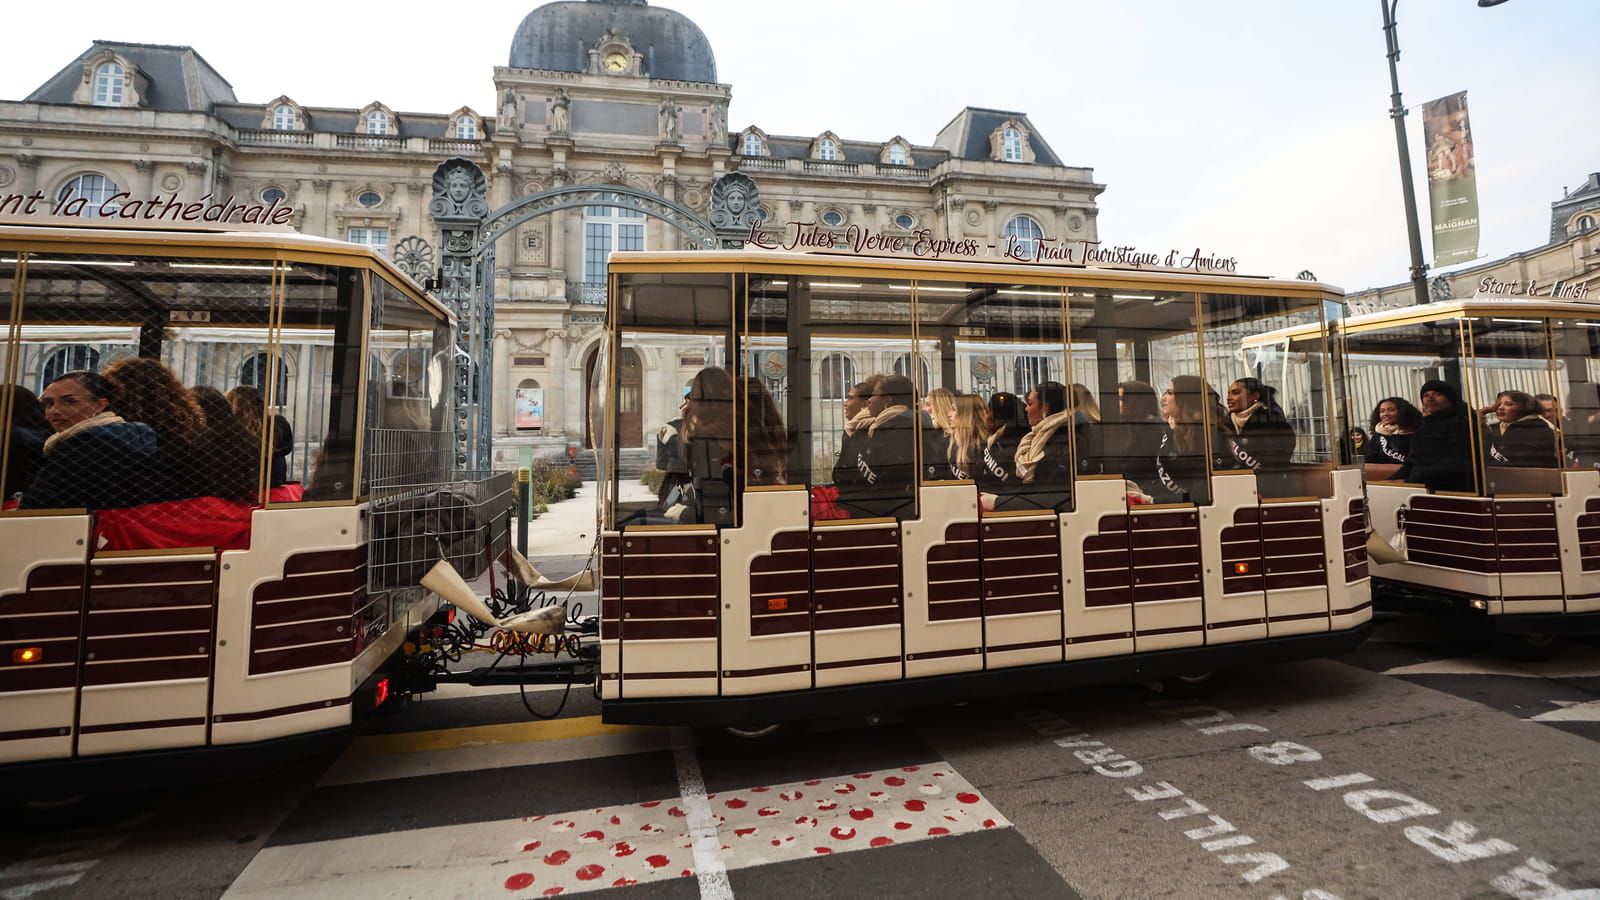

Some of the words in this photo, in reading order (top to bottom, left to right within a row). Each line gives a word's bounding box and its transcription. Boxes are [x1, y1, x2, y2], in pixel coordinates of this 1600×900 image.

[0, 189, 45, 215] nt
[52, 187, 88, 216] la
[98, 191, 293, 225] Cathédrale
[1434, 217, 1477, 231] MAIGNAN
[745, 219, 778, 250] Le
[783, 221, 837, 251] Jules
[846, 225, 904, 253] Verne
[912, 228, 980, 258] Express
[1003, 235, 1031, 262] Le
[1033, 236, 1073, 263] Train
[1079, 240, 1160, 268] Touristique
[1181, 248, 1238, 272] Amiens
[1478, 277, 1517, 295] Start
[1551, 281, 1589, 299] Finish
[1124, 781, 1290, 883] VILLE
